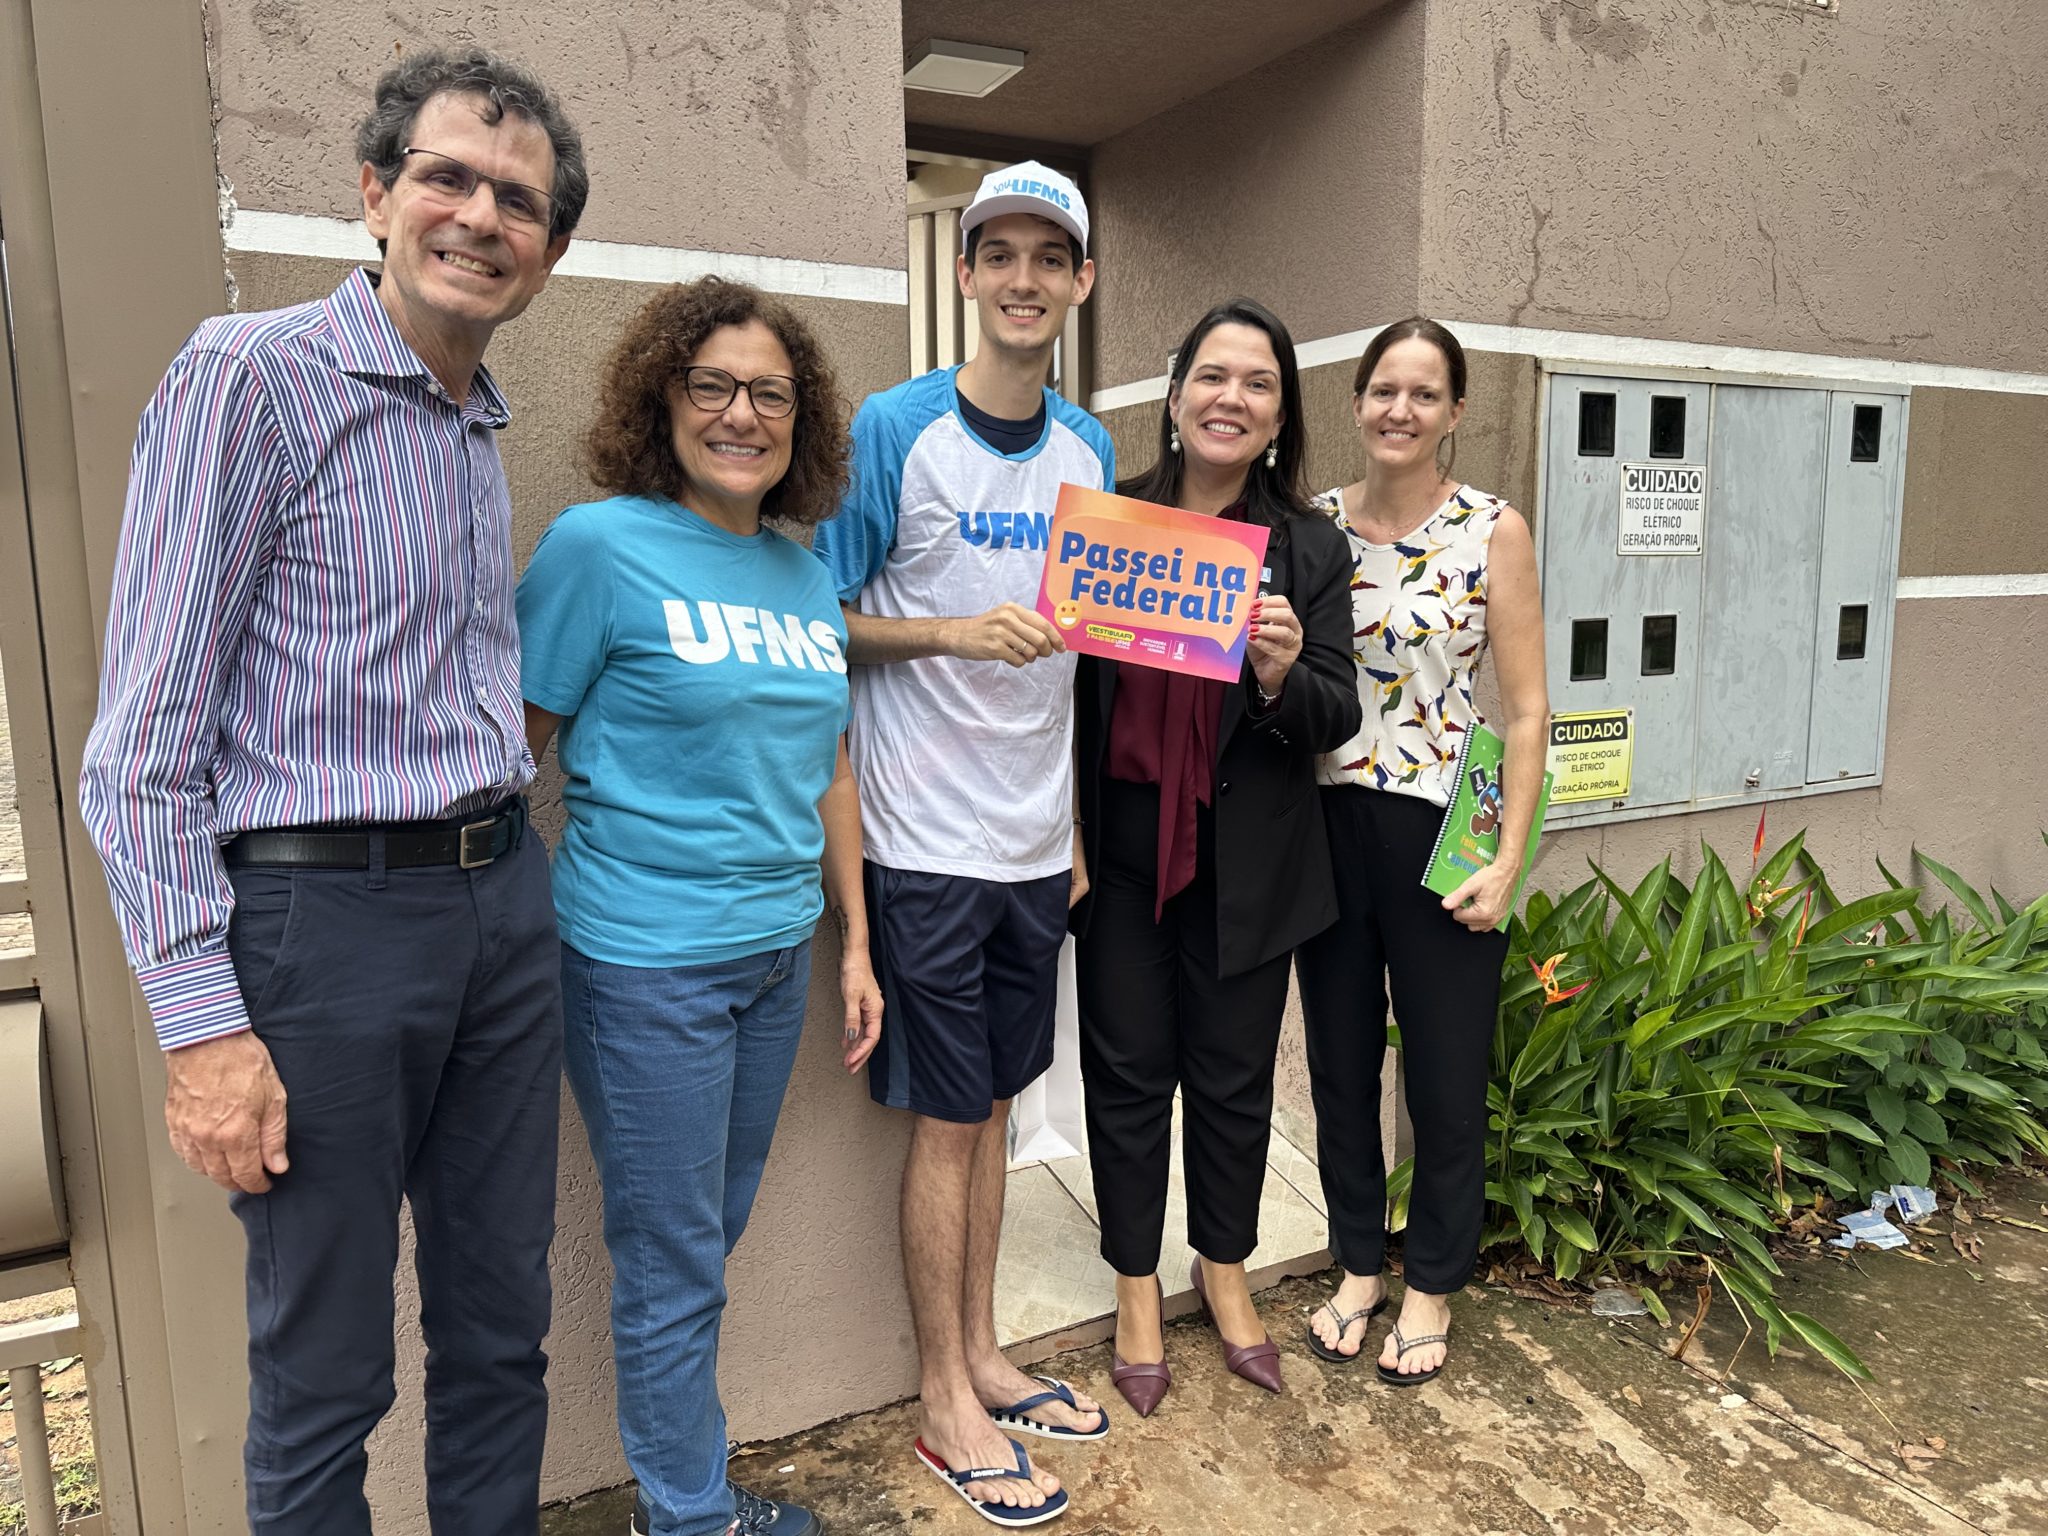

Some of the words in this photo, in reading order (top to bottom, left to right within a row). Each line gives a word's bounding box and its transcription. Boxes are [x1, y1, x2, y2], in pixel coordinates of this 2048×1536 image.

[993, 179, 1012, 194] sou
[1012, 178, 1070, 210] UFMS
[1625, 470, 1702, 493] CUIDADO
[1626, 497, 1651, 510] RISCO
[1653, 498, 1664, 510] DE
[1666, 498, 1700, 511] CHOQUE
[957, 511, 1054, 551] UFM
[1623, 531, 1661, 549] GERAÇÃO
[1663, 531, 1698, 546] PRÓPRIA
[1059, 531, 1184, 583] Passei
[1194, 560, 1248, 593] na
[1070, 568, 1237, 625] Federal!
[662, 599, 848, 675] UFMS
[1554, 721, 1624, 742] CUIDADO
[1555, 753, 1577, 763] RISCO
[1579, 751, 1589, 761] DE
[1590, 749, 1621, 760] CHOQUE
[1552, 781, 1589, 794] GERAÇÃO
[1590, 779, 1619, 790] PRÓPRIA
